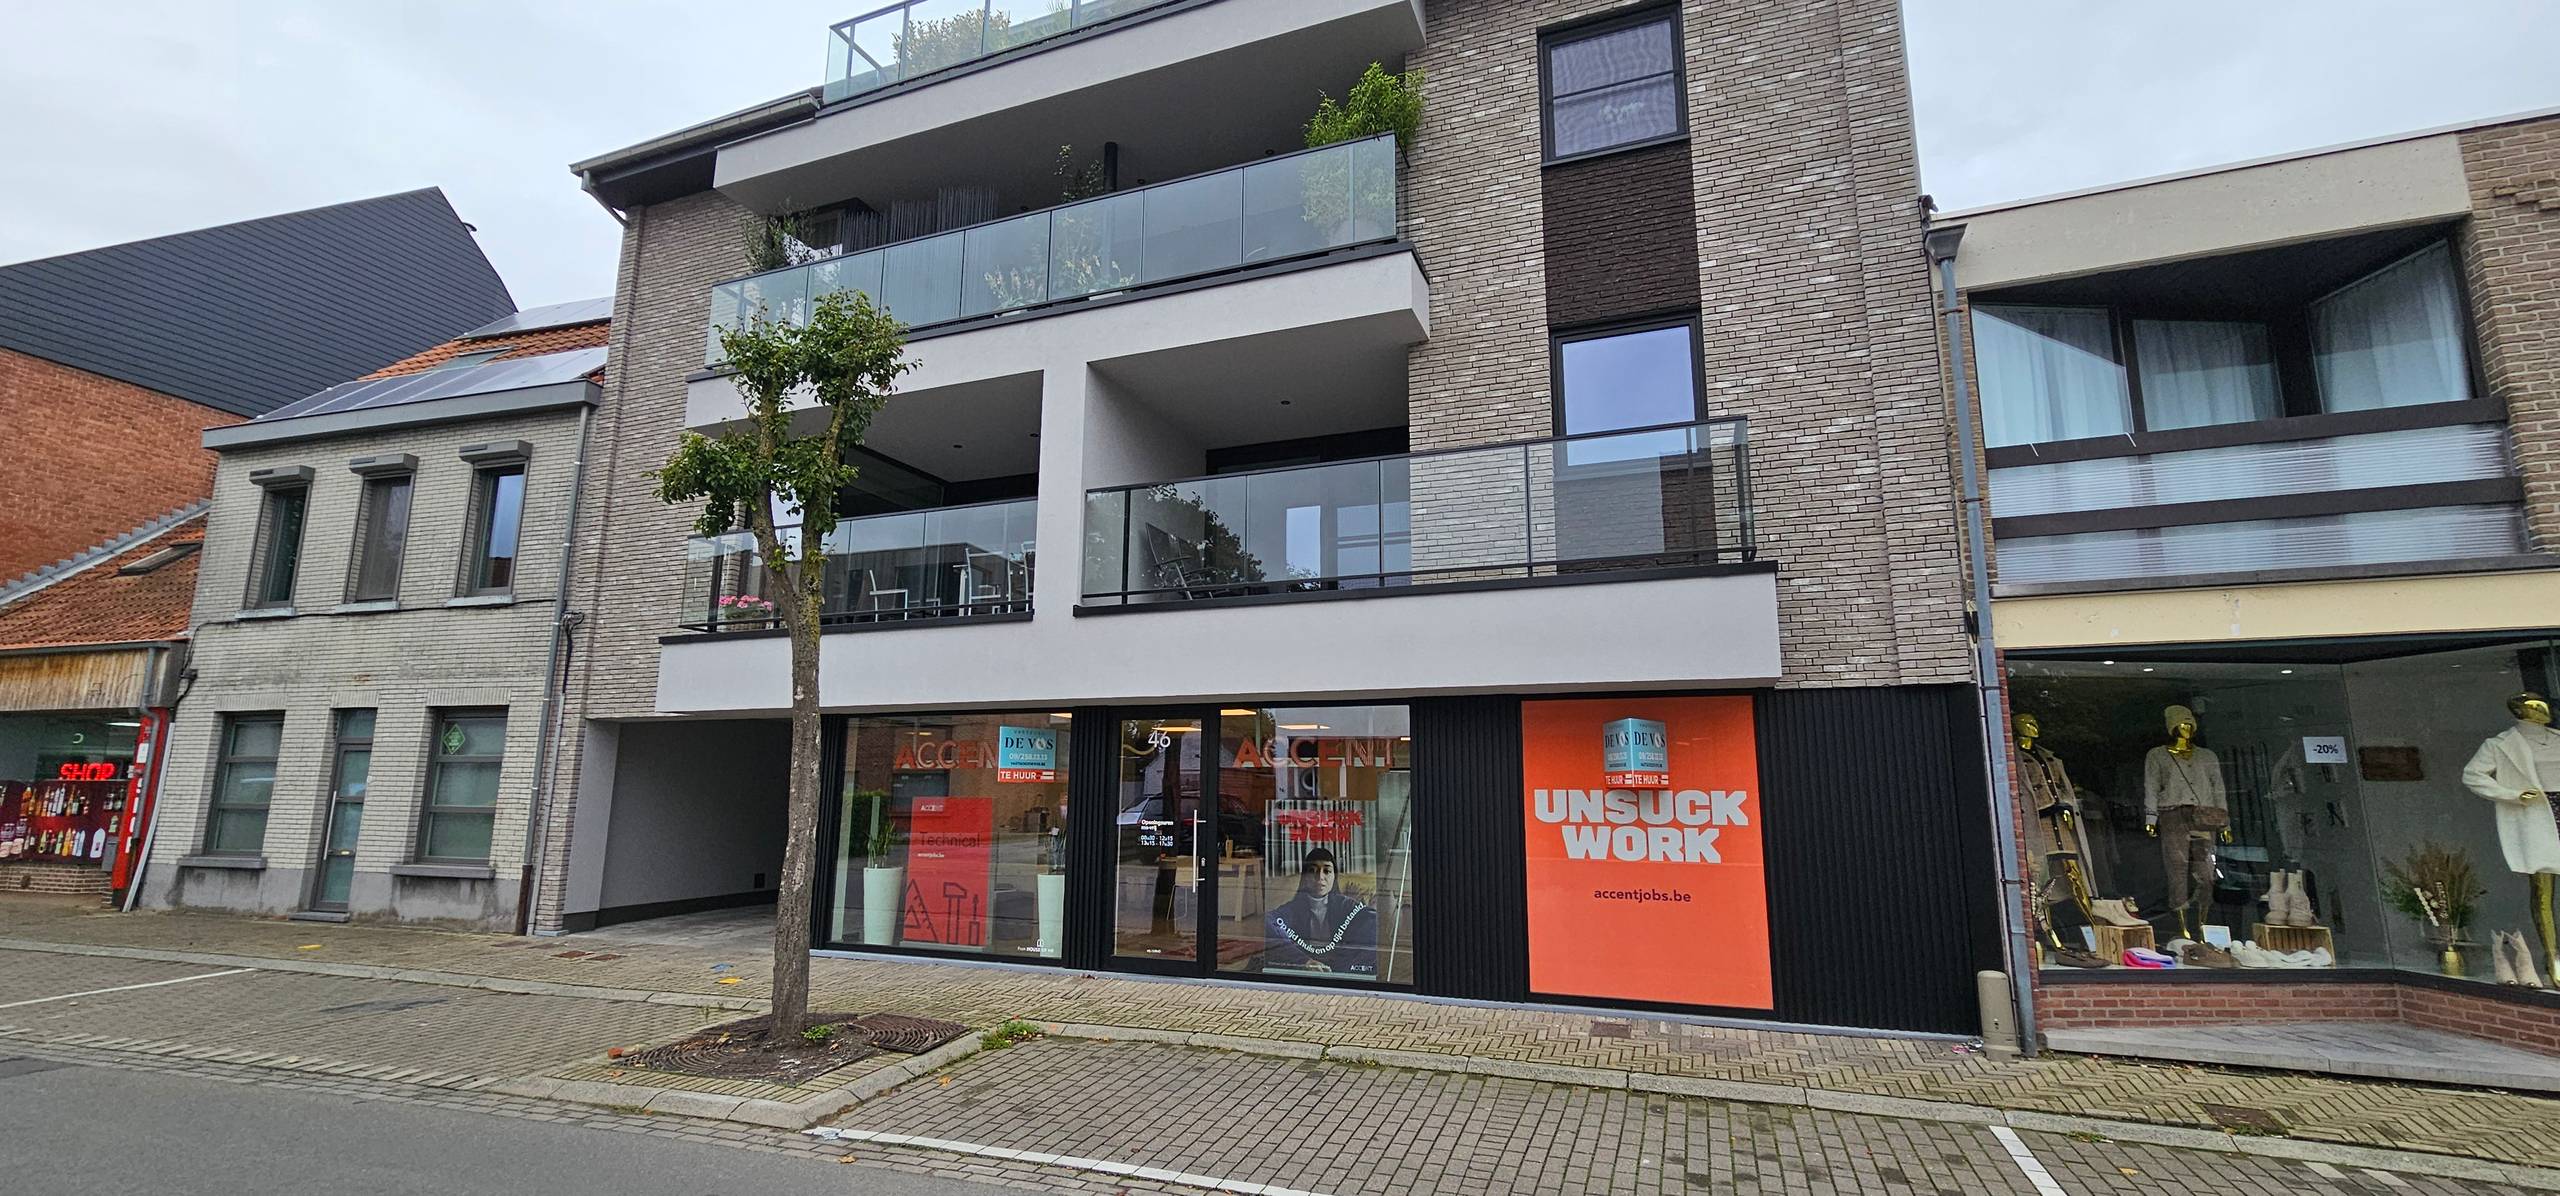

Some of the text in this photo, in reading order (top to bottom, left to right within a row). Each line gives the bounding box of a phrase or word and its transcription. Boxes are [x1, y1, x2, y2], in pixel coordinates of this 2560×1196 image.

[1005, 737, 1053, 750] DE VOS
[1148, 730, 1171, 748] 46
[1634, 731, 1666, 748] DE VOS
[895, 741, 998, 769] ACCEN
[1232, 735, 1395, 769] ACCENT
[2313, 744, 2339, 754] -20%
[60, 762, 116, 780] SHOP
[1000, 771, 1037, 780] TE HUUR
[1634, 774, 1659, 785] TE HUUR
[1534, 789, 1749, 826] UNSUCK
[920, 831, 981, 848] Technical
[1561, 825, 1722, 864] WORK
[1594, 889, 1692, 902] accentjobs.be
[1276, 917, 1288, 931] Op
[1297, 938, 1315, 954] thuis
[1325, 941, 1336, 952] op
